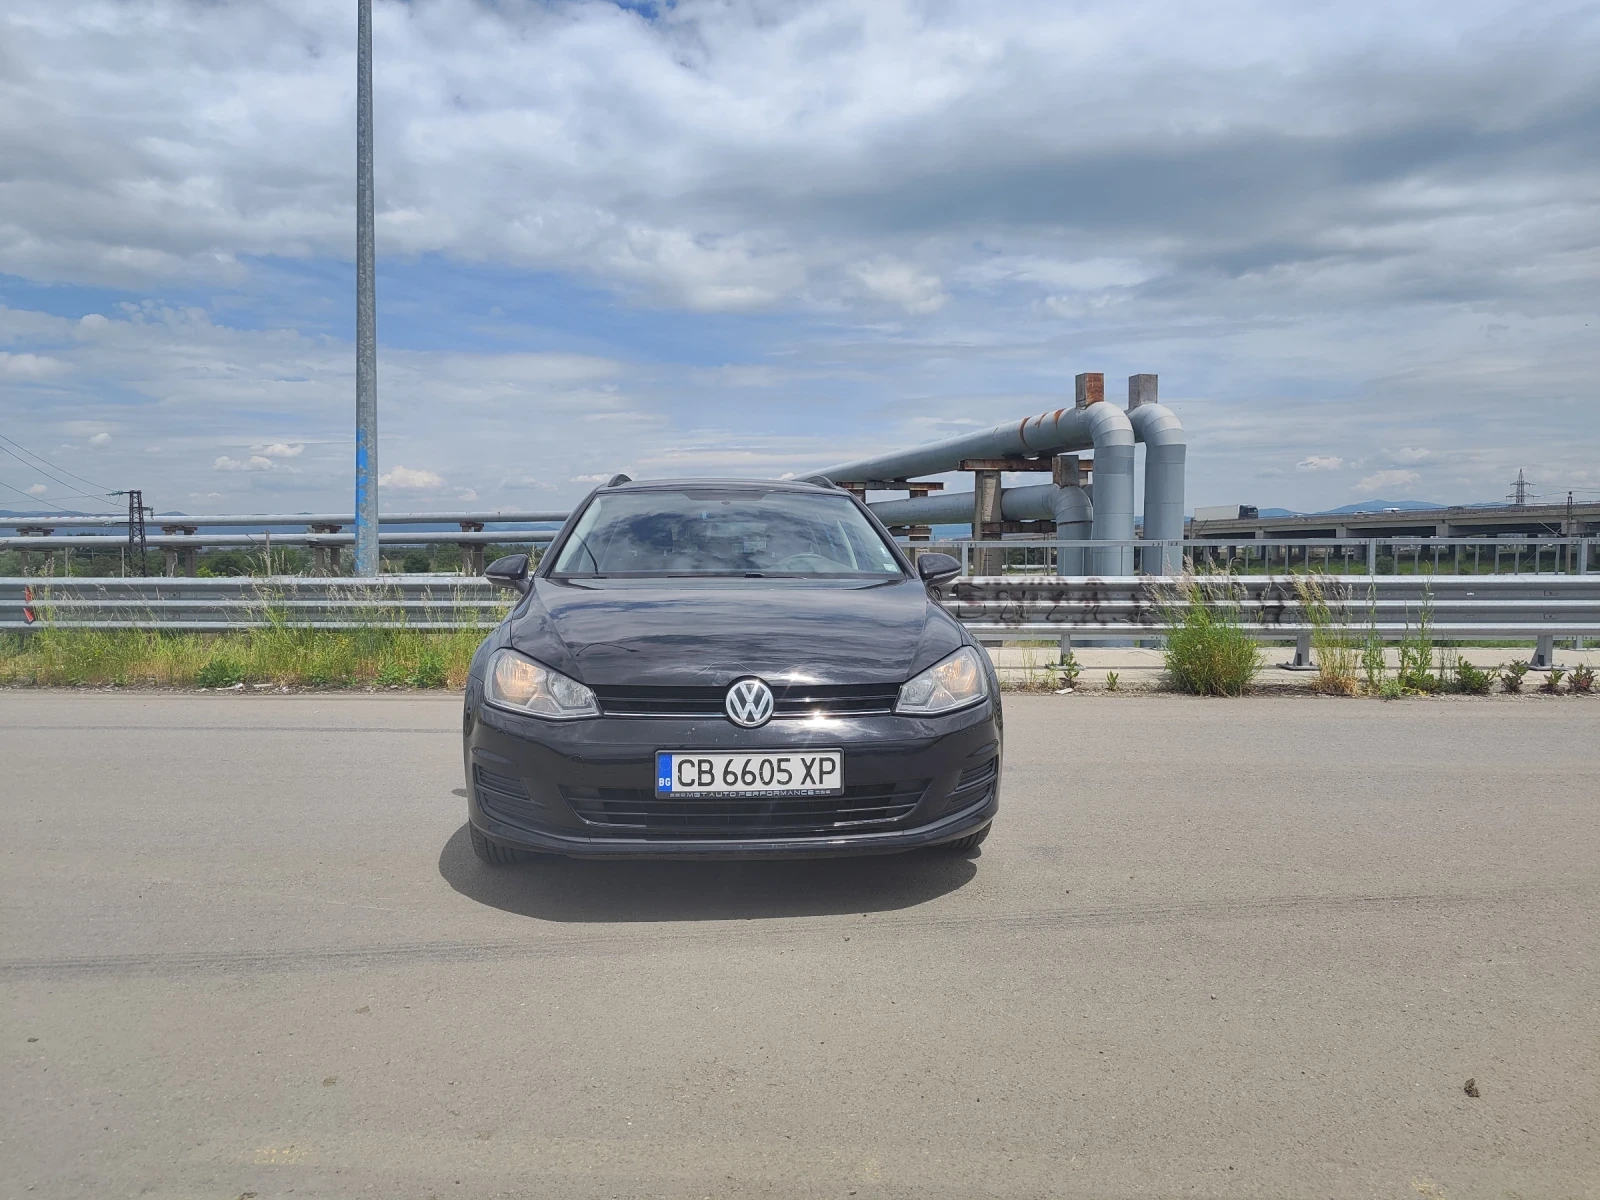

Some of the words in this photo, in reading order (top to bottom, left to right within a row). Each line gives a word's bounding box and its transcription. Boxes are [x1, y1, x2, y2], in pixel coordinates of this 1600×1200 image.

[678, 759, 715, 787] CB
[722, 758, 793, 786] 6605
[800, 757, 836, 785] XP
[659, 778, 671, 786] BG
[738, 789, 814, 797] PERFORMANCE
